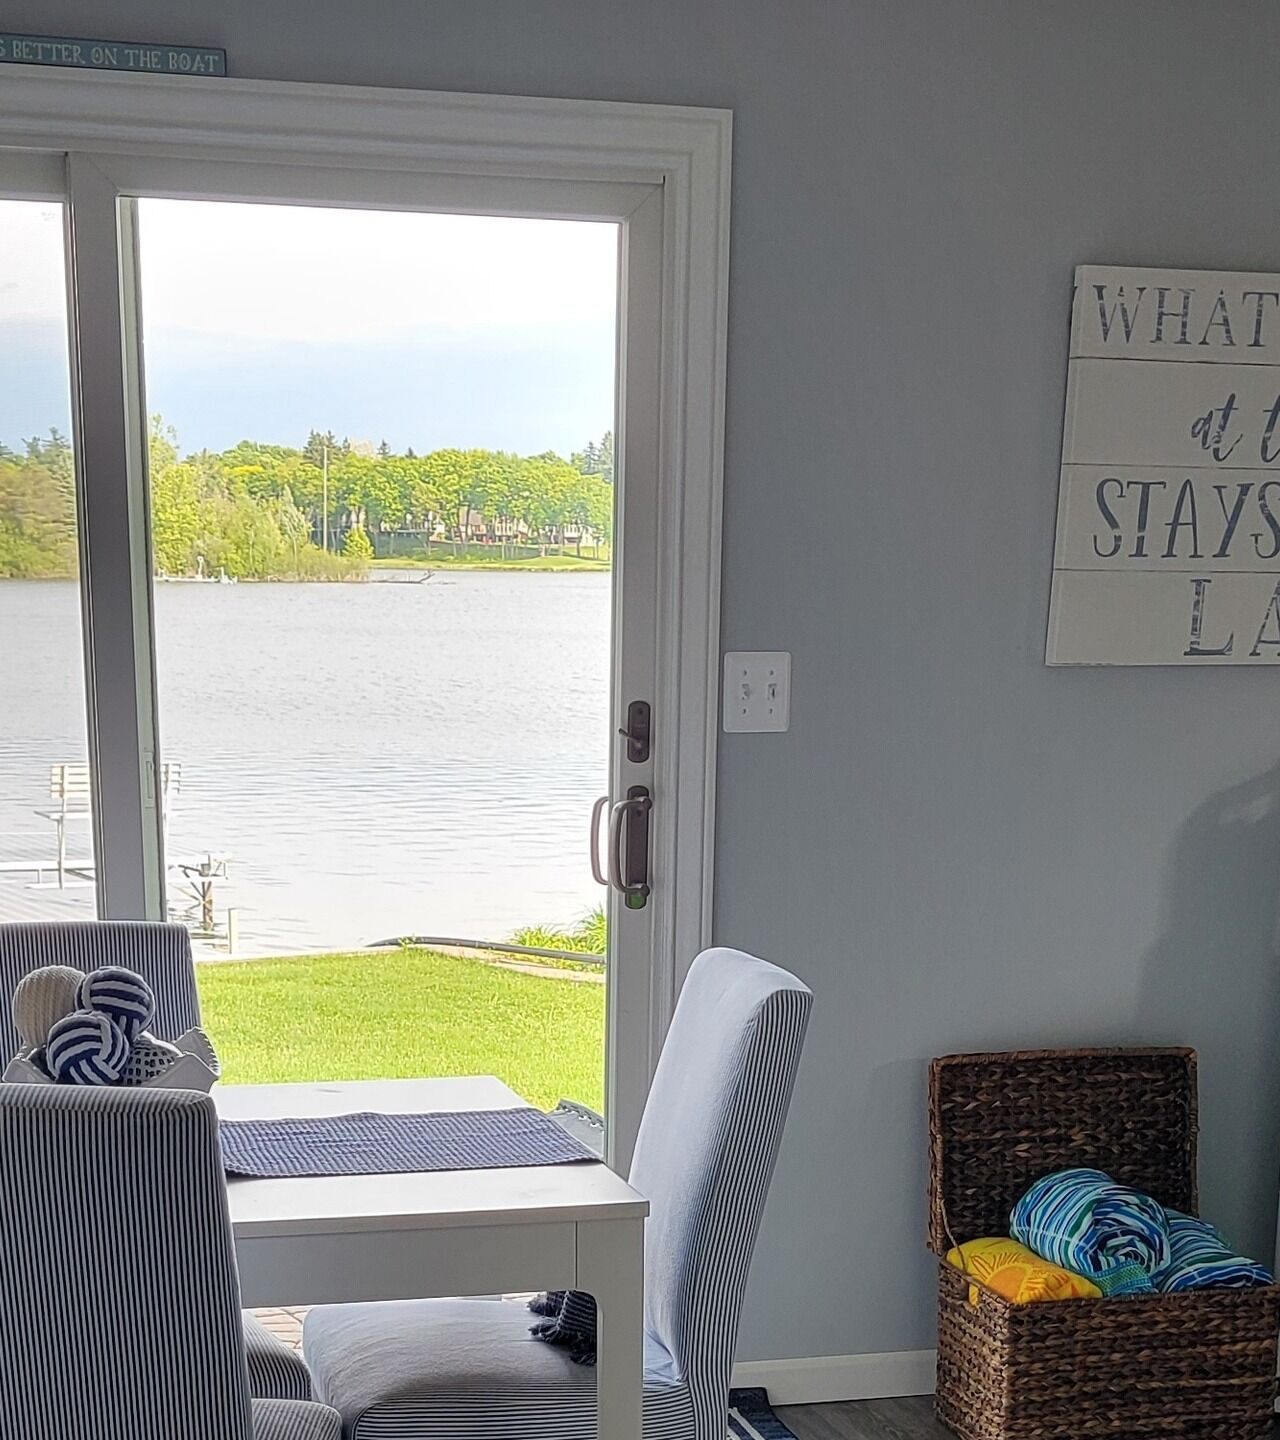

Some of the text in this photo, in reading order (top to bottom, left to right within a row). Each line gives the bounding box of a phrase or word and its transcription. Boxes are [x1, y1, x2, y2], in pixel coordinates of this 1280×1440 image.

[12, 40, 86, 65] BETTER
[91, 46, 118, 66] ON
[124, 48, 161, 69] THE
[168, 52, 219, 72] BOAT
[1093, 285, 1279, 348] WHAT
[1190, 392, 1242, 462] at
